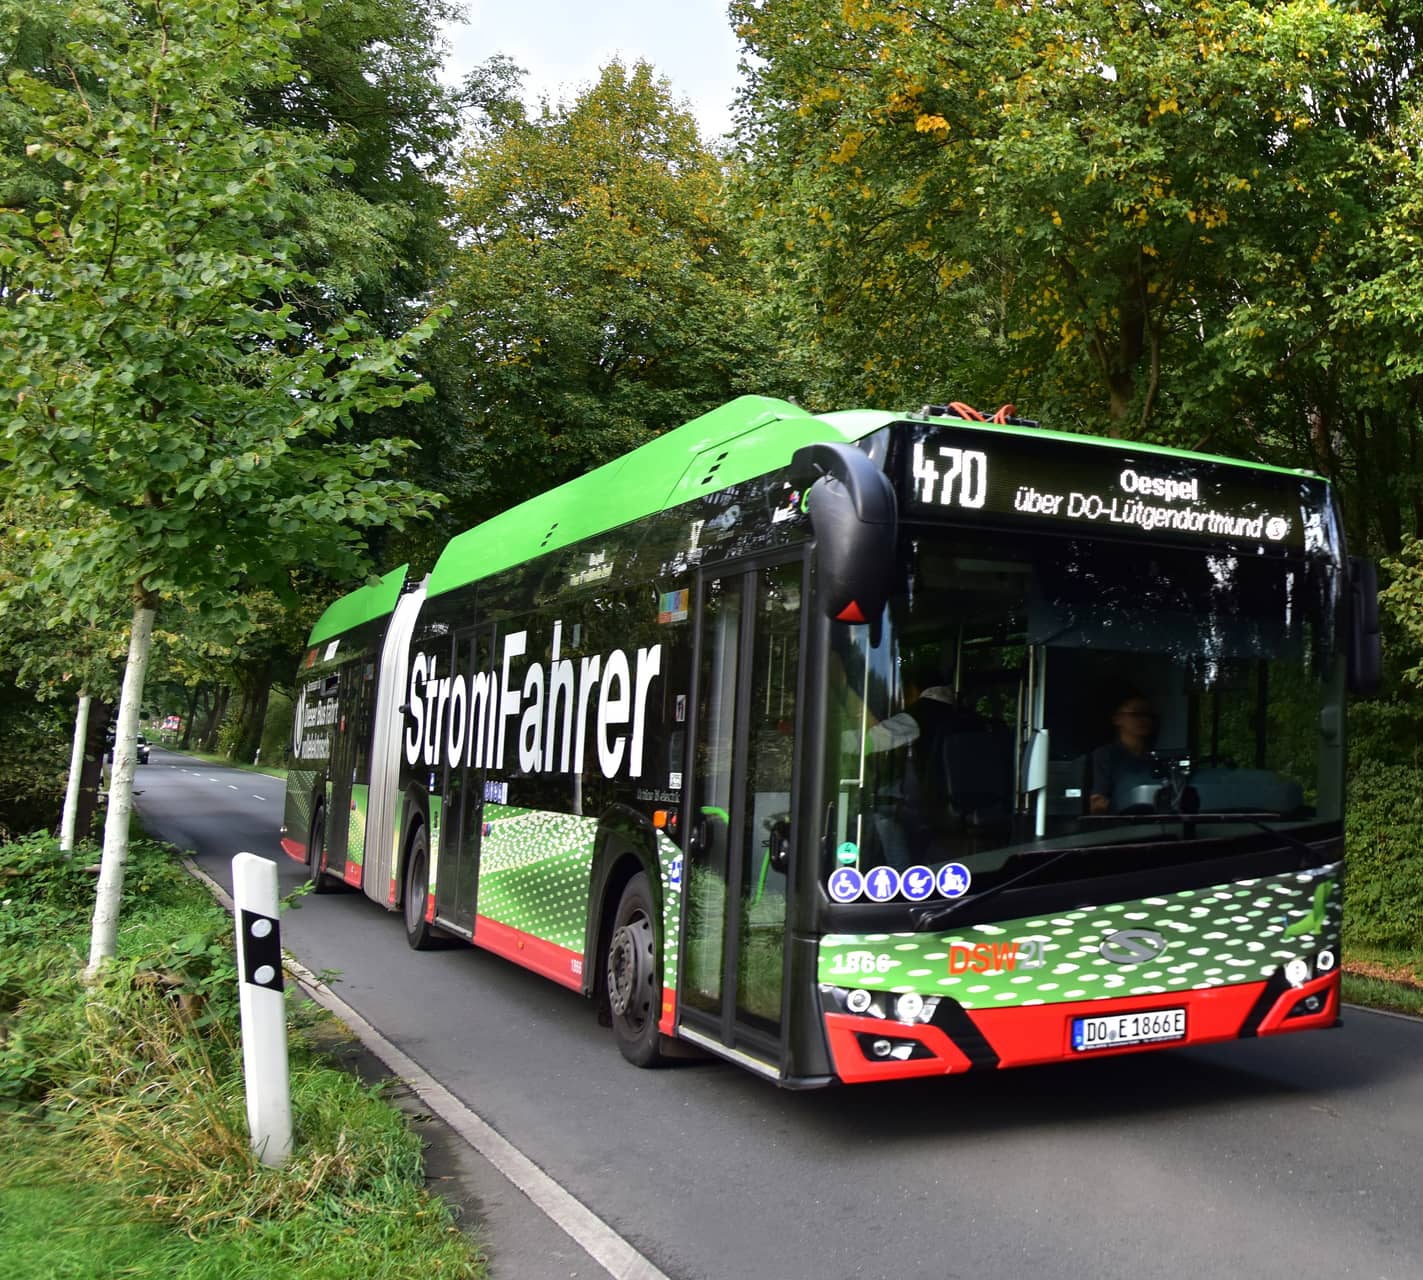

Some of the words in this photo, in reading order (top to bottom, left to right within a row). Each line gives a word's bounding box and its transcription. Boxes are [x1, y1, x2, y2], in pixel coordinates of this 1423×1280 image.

[912, 443, 987, 509] 470
[1119, 469, 1199, 502] Oespel
[1014, 486, 1064, 515] über
[1067, 492, 1263, 539] DO-Lütgendortmund
[406, 619, 662, 779] StromFahrer
[831, 952, 892, 974] 1866
[948, 940, 1046, 976] DSW21
[1087, 1022, 1108, 1042] DO
